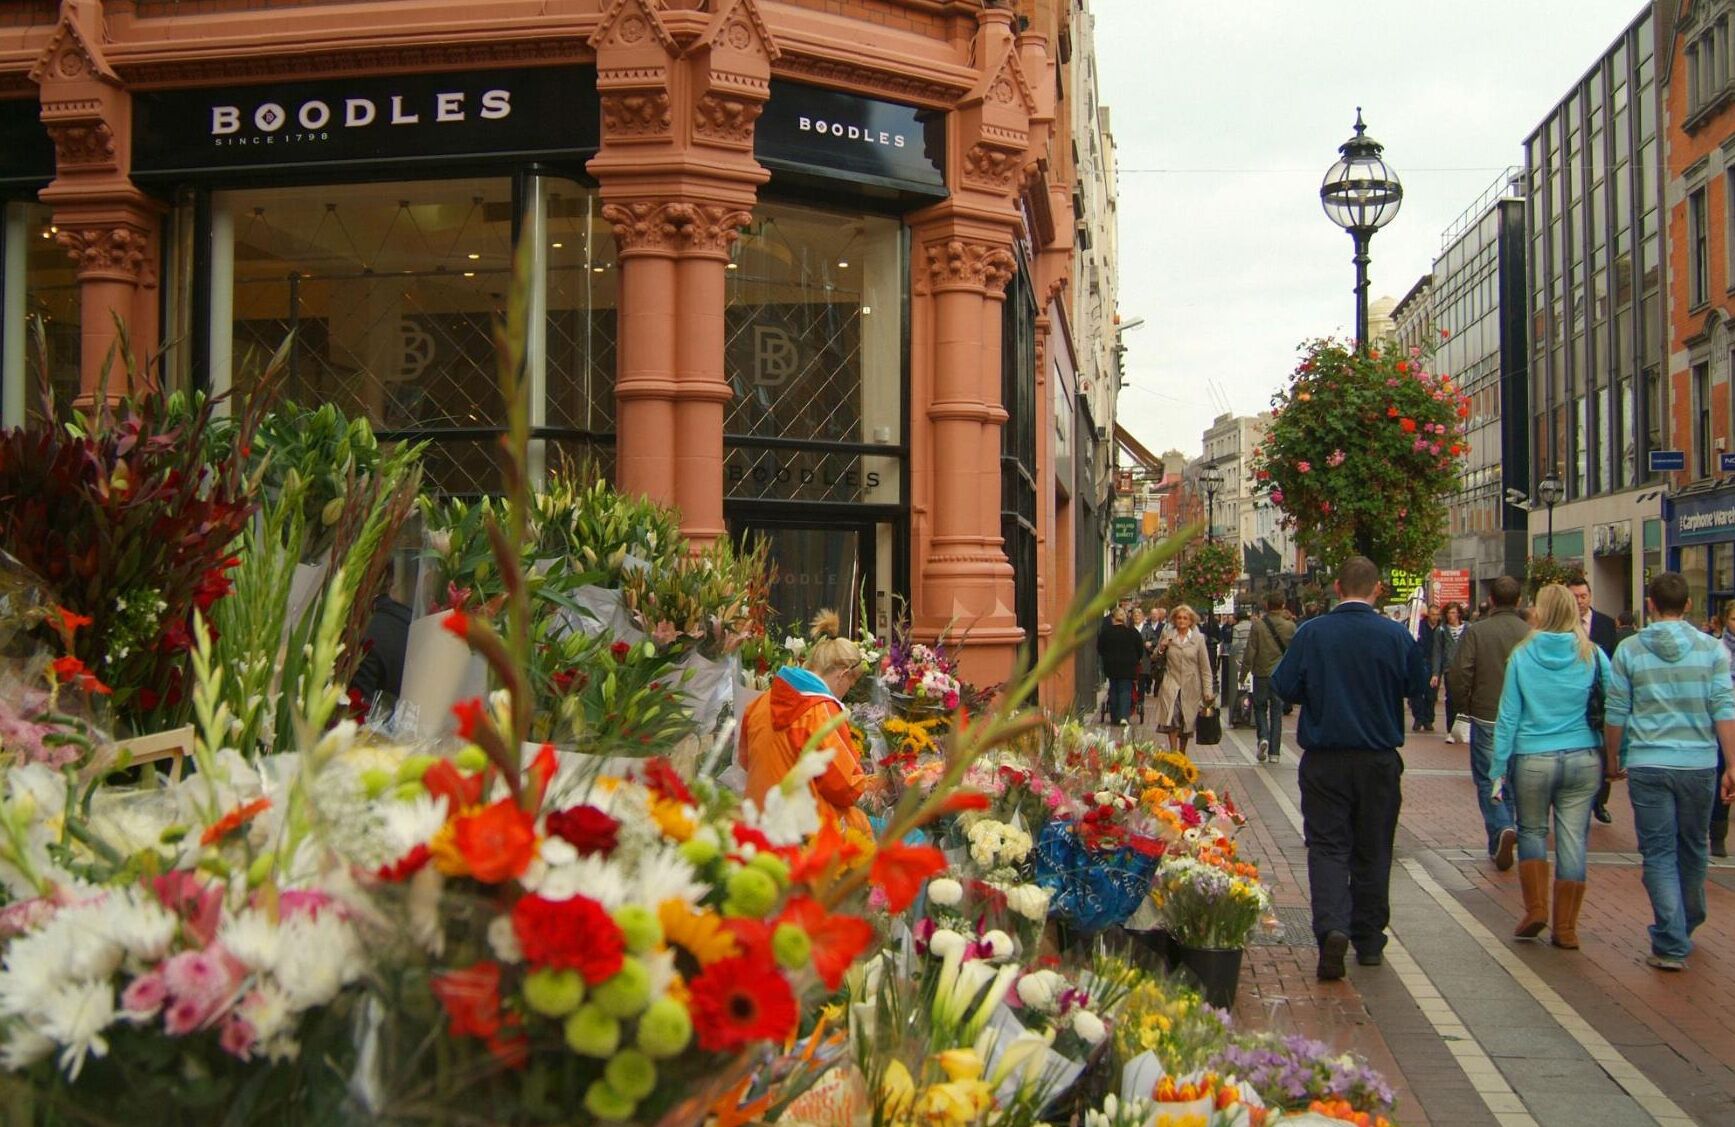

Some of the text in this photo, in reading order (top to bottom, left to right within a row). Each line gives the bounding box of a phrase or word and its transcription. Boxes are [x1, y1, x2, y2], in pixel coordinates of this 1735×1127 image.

[211, 90, 511, 134] BOODLES
[215, 132, 329, 146] SINCE 1798
[799, 117, 904, 147] BOODLES
[1683, 512, 1713, 531] Carphone
[1392, 578, 1422, 586] SALE
